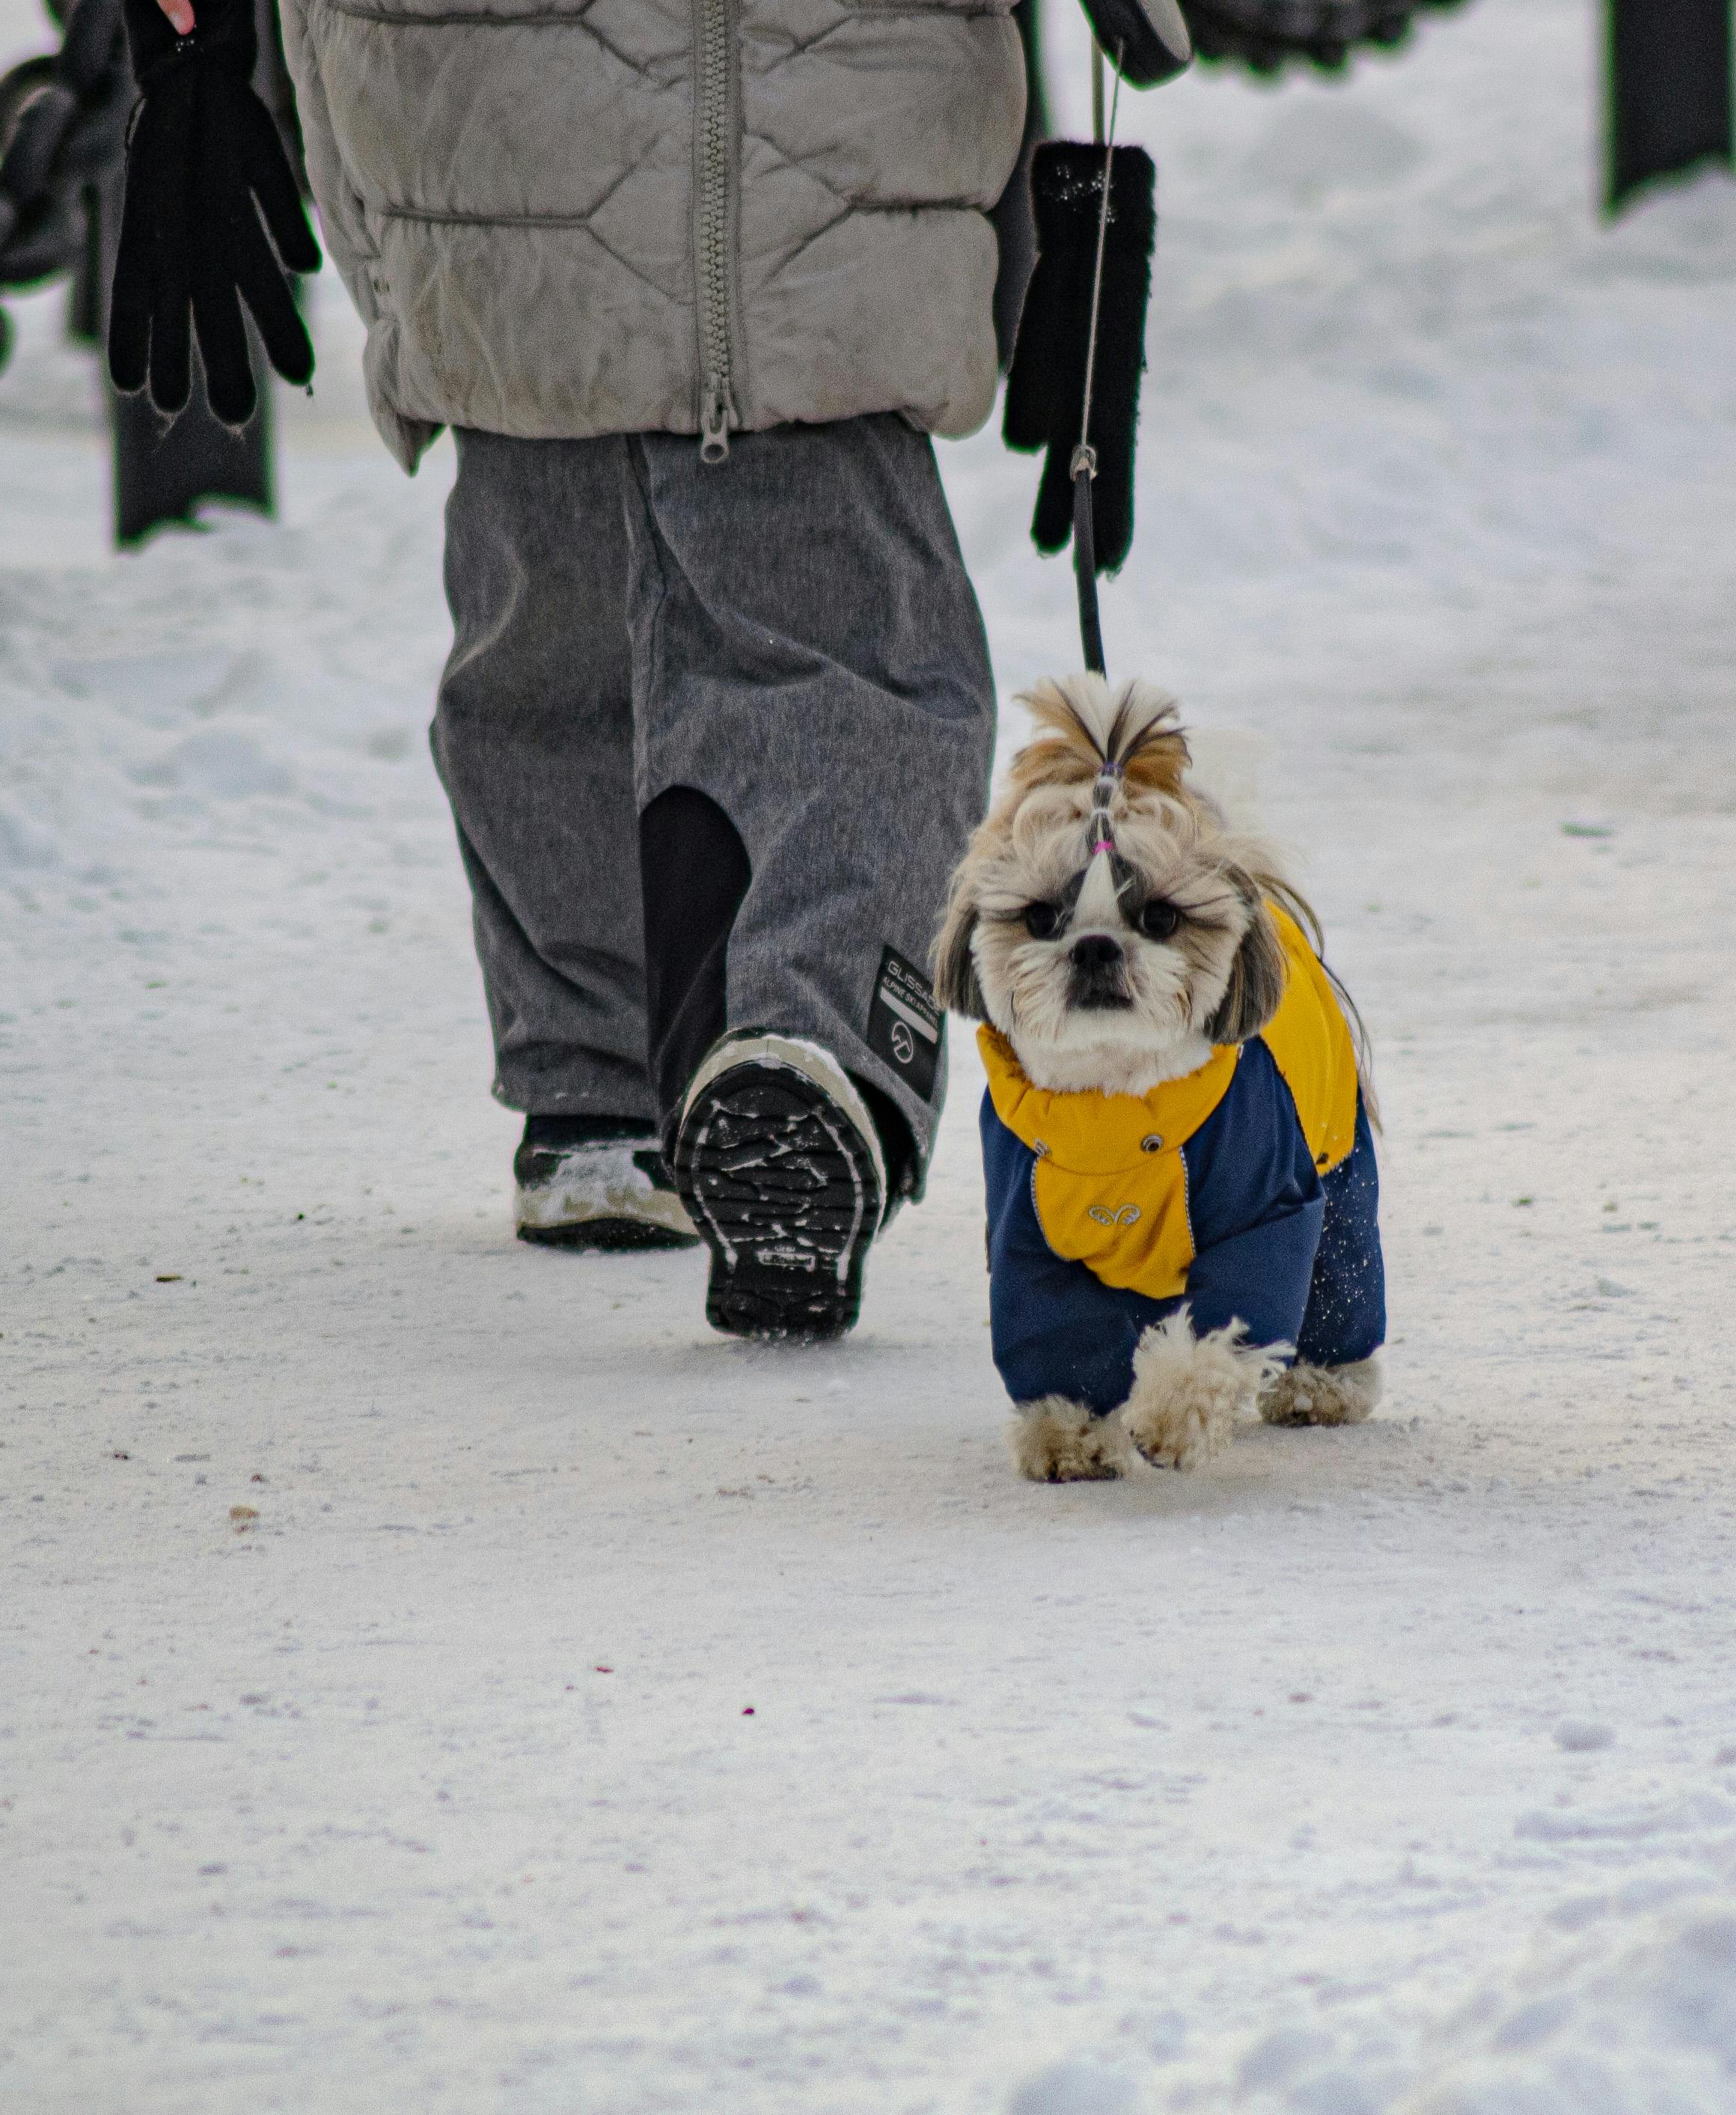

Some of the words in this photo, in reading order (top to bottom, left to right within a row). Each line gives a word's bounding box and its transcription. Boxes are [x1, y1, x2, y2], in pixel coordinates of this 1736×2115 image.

[883, 976, 906, 998] ALPINE
[905, 993, 917, 1005] SKI
[887, 960, 938, 1015] GLISSAD
